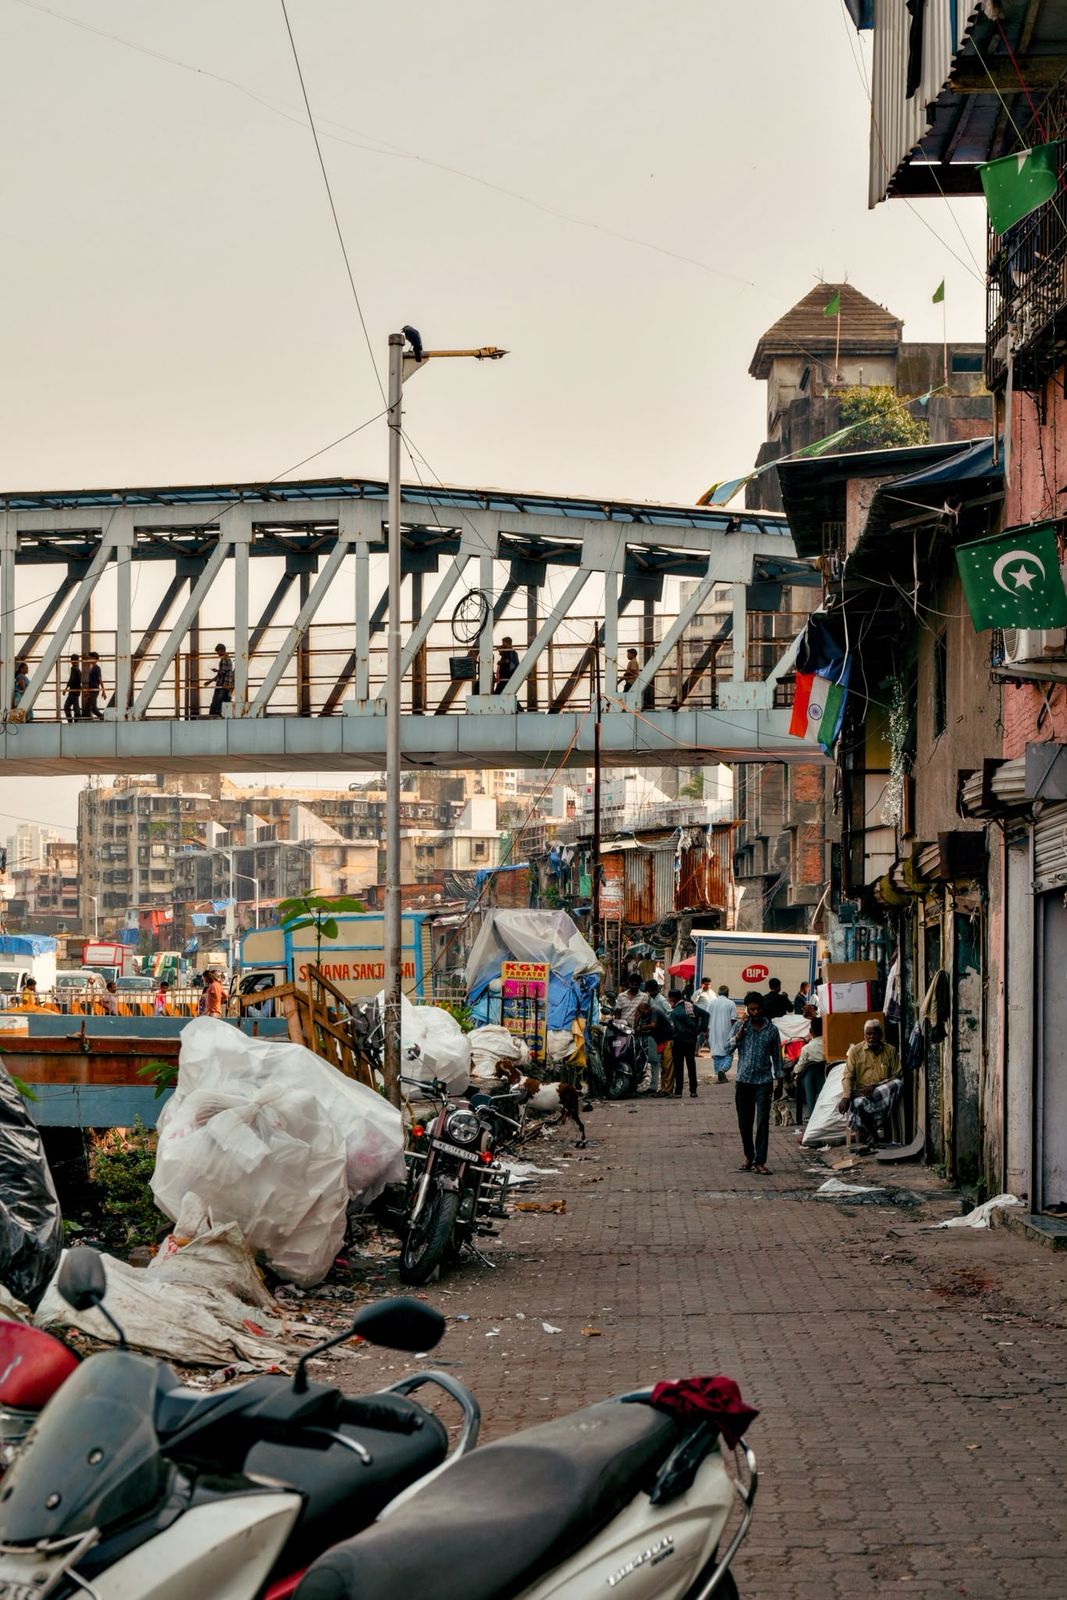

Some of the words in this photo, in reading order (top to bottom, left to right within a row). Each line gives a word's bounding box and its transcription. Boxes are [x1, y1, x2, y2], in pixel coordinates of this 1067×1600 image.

[505, 963, 546, 972] KGN
[505, 970, 546, 978] TARPATRI
[746, 968, 768, 978] BIPL
